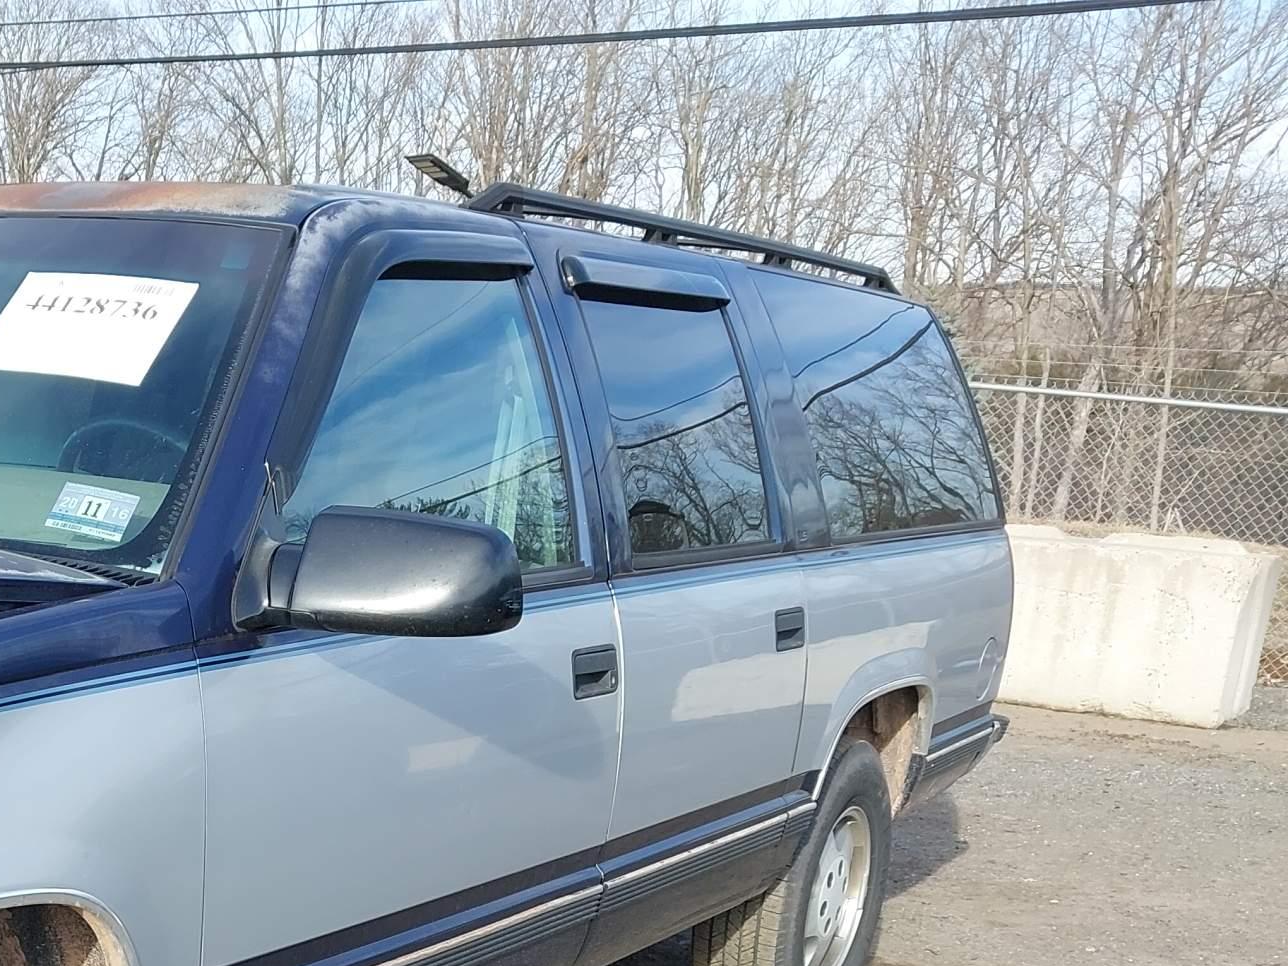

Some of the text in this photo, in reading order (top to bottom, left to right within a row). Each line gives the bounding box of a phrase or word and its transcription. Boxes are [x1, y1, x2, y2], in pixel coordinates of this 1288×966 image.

[25, 294, 159, 321] 44128736
[58, 496, 130, 520] 20 11 16
